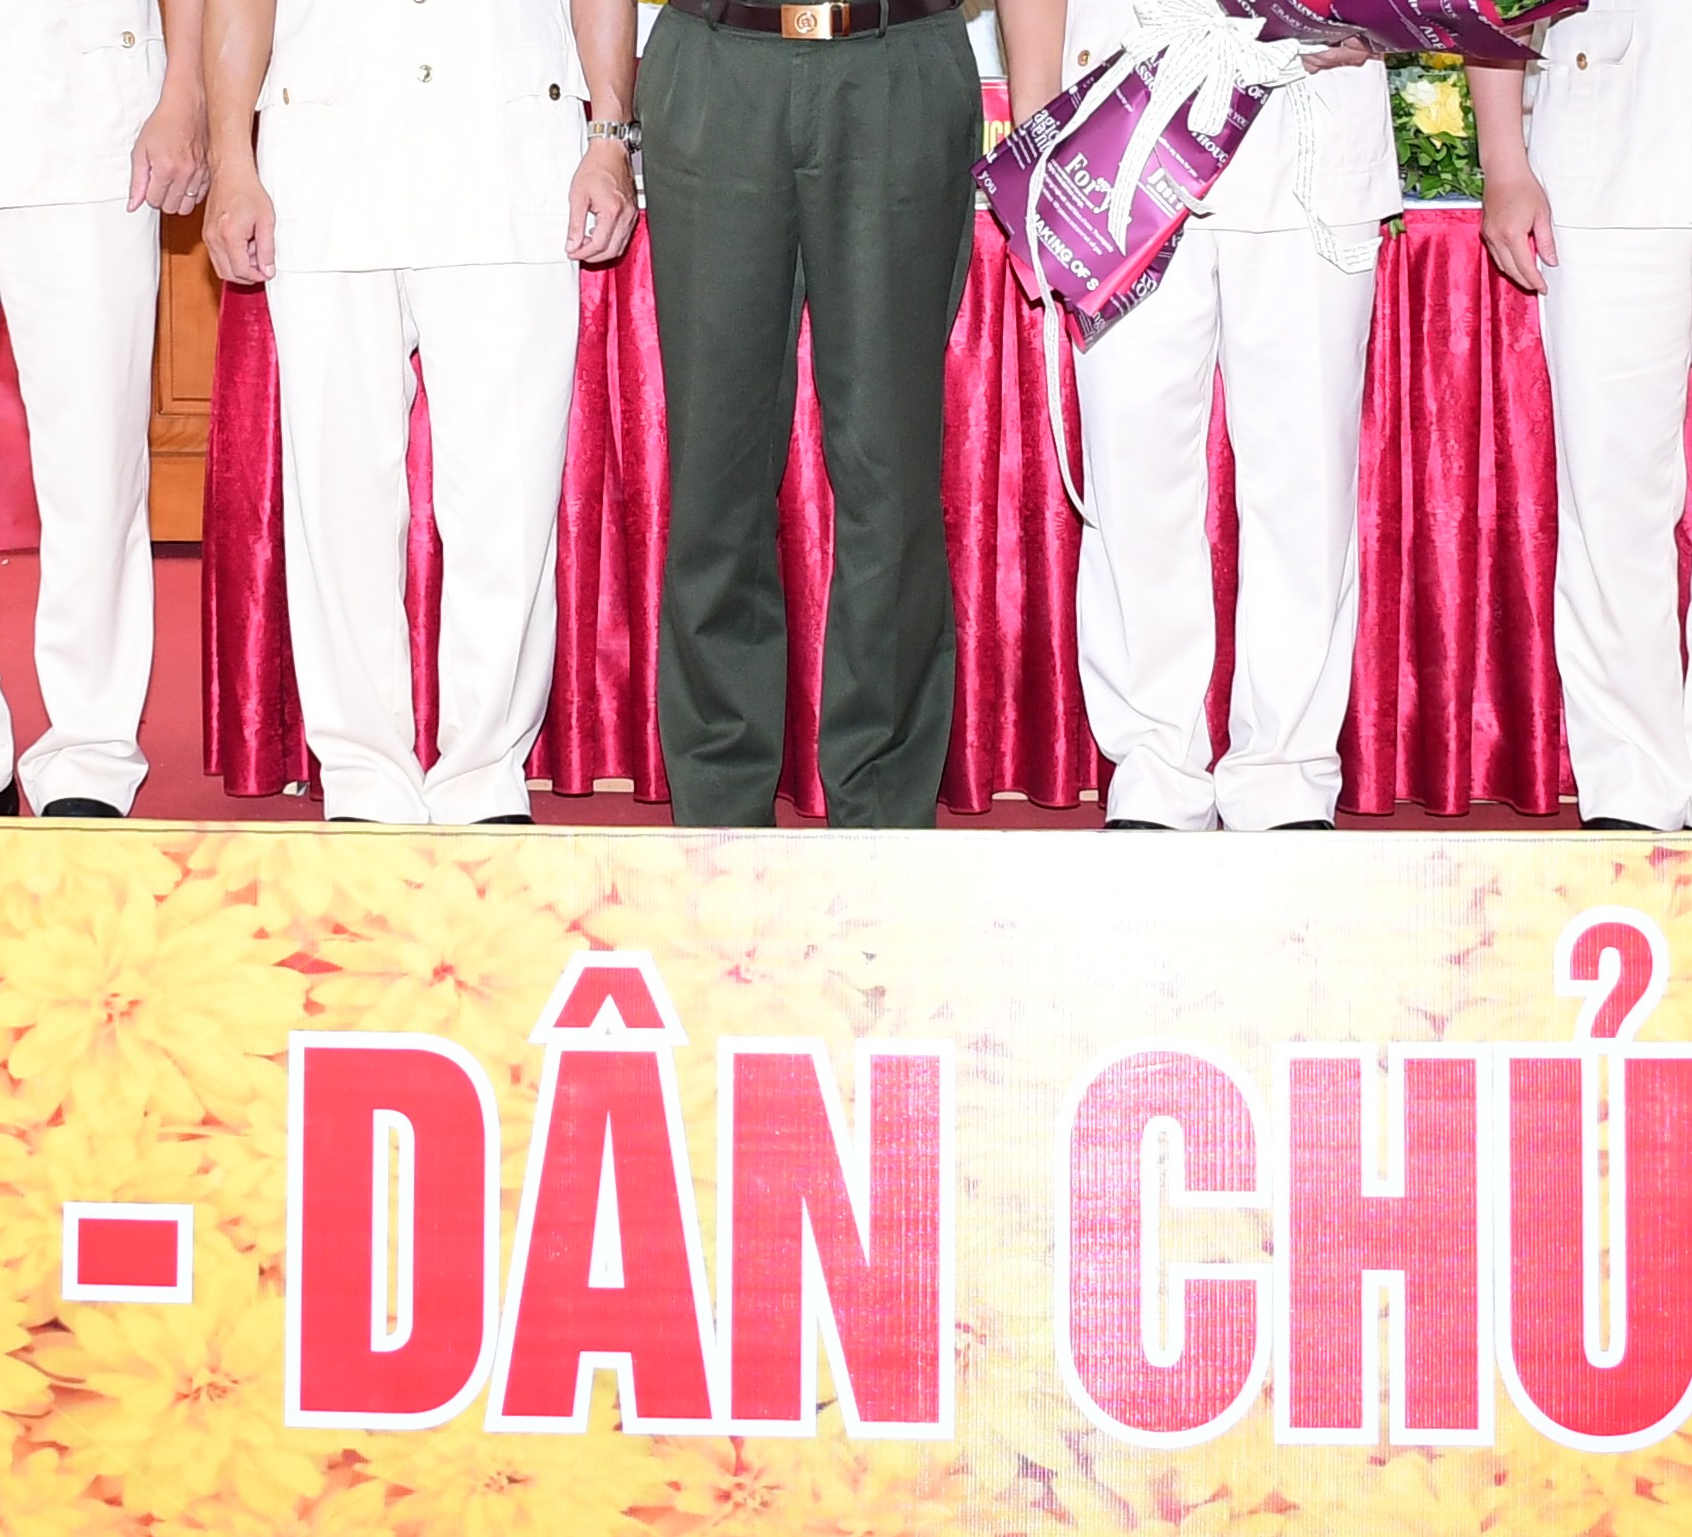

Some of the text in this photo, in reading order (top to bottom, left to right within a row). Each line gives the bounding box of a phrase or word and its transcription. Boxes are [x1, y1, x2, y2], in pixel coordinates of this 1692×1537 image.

[977, 169, 998, 196] you
[1064, 151, 1097, 197] For
[1070, 259, 1092, 280] OF
[289, 952, 952, 1438] DÂN
